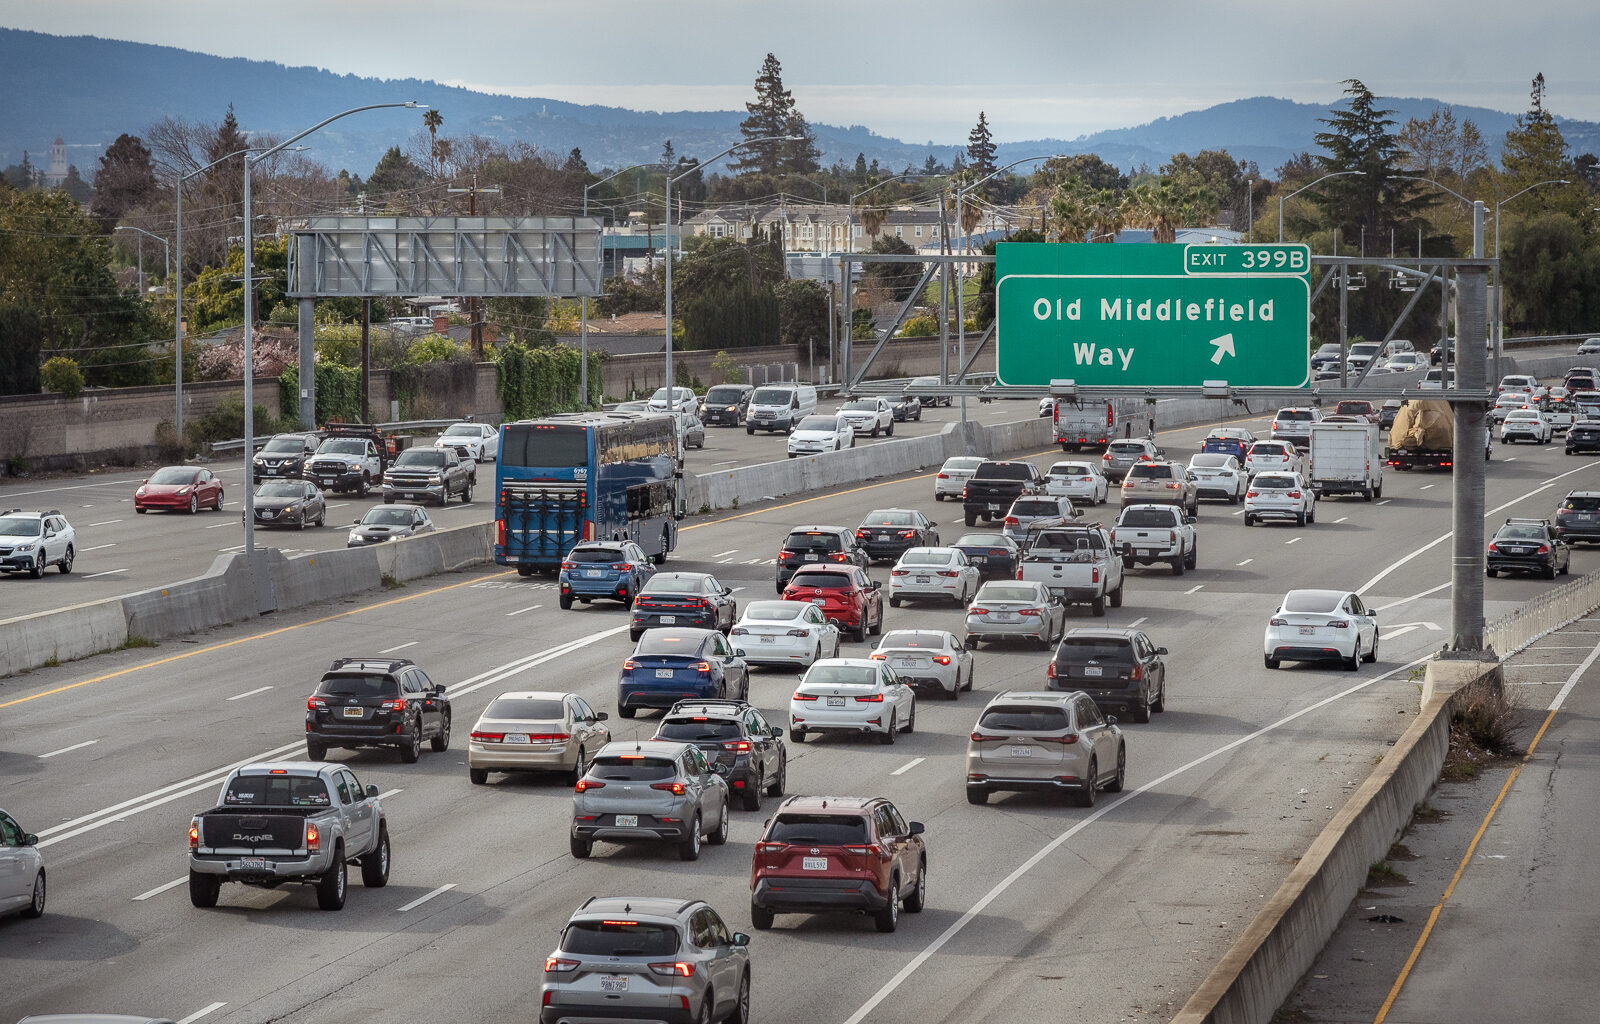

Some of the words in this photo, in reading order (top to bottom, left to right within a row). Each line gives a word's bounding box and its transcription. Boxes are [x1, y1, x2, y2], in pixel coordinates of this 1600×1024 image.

[1191, 253, 1227, 266] EXIT
[1241, 250, 1305, 268] 399B
[1033, 297, 1081, 321] Old
[1100, 297, 1274, 322] Middlefield
[1073, 342, 1135, 371] Way
[232, 834, 274, 842] DAKINE
